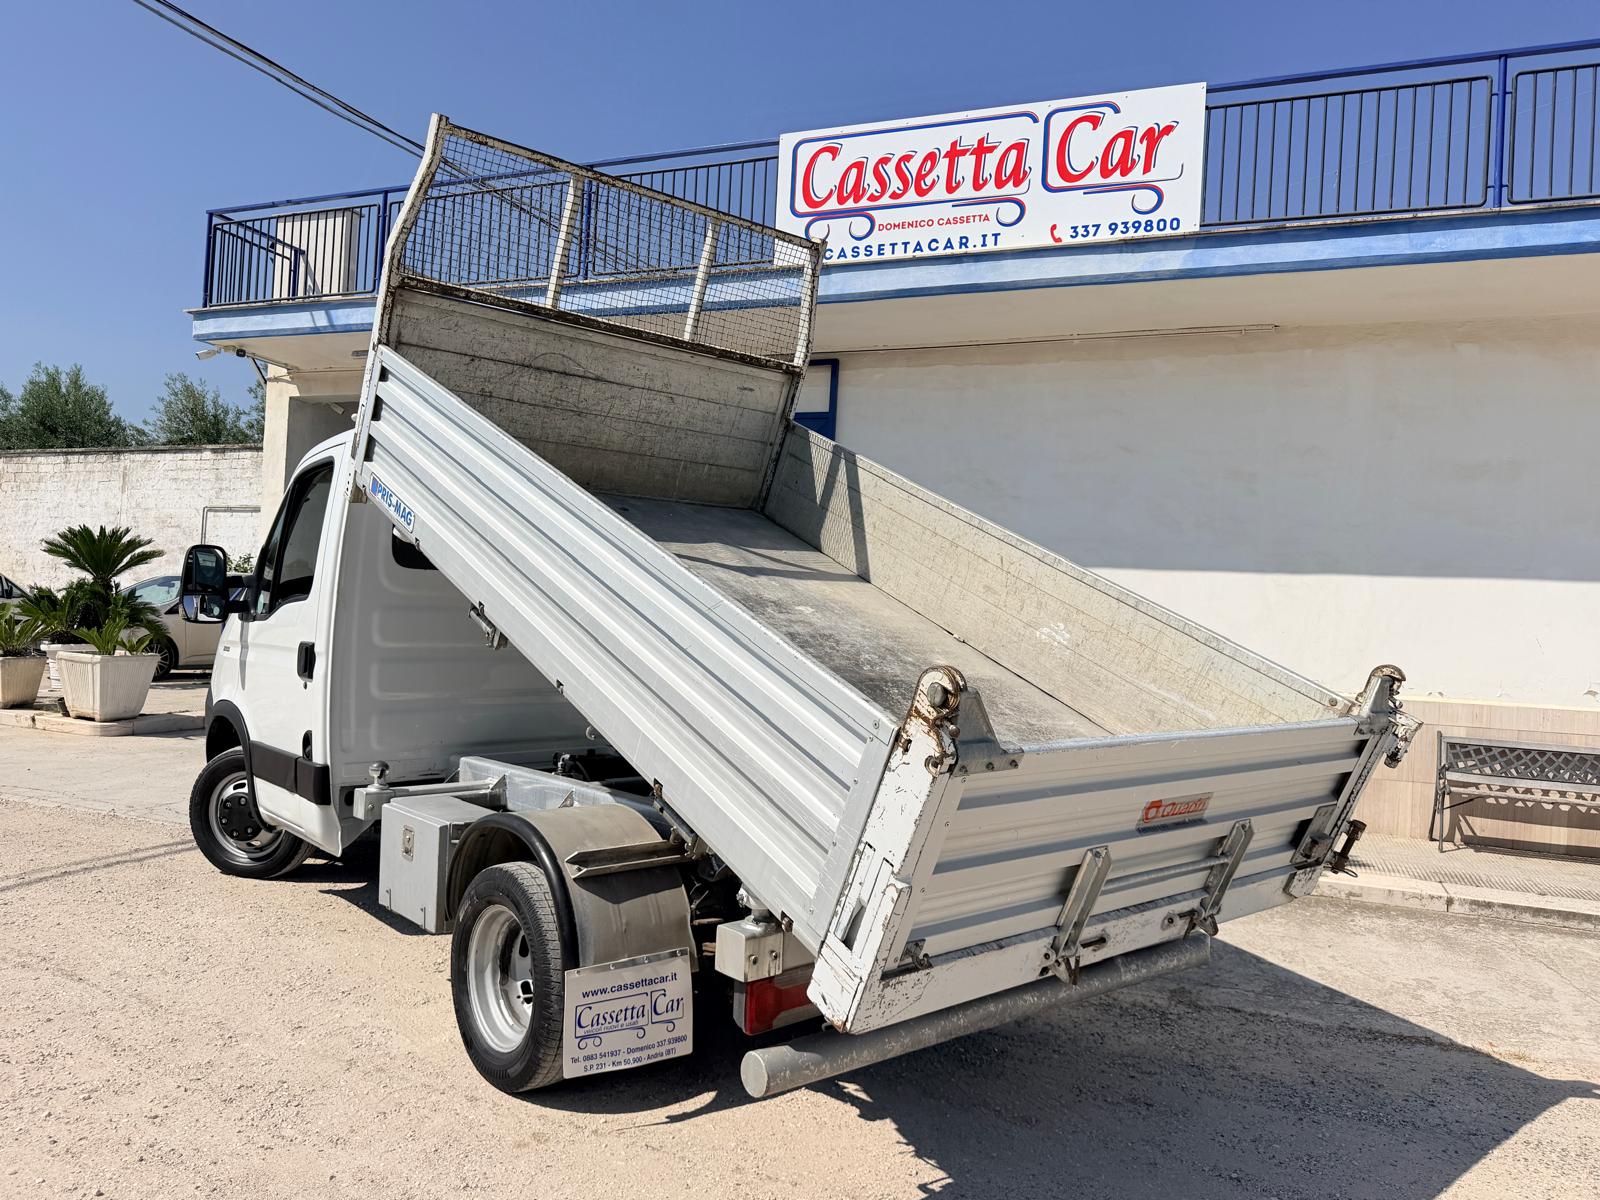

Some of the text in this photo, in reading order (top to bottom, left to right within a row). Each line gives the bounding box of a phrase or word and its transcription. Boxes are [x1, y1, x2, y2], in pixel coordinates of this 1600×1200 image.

[802, 111, 1179, 209] Cassetta Car
[878, 214, 991, 231] DOMENICO CASSETTA
[1070, 217, 1181, 239] 337 939800
[824, 232, 1001, 260] CASSETTACAR.IT
[377, 482, 412, 527] PRIS-MAG
[582, 972, 678, 998] www.cassettacar.it
[577, 992, 684, 1029] Cassetta Car
[570, 1056, 581, 1064] Tel.
[599, 1049, 621, 1059] 541937
[626, 1043, 656, 1055] Domenico
[583, 1064, 595, 1072] S.P.
[595, 1062, 607, 1070] 231
[611, 1060, 623, 1068] Km
[647, 1051, 664, 1061] Andria
